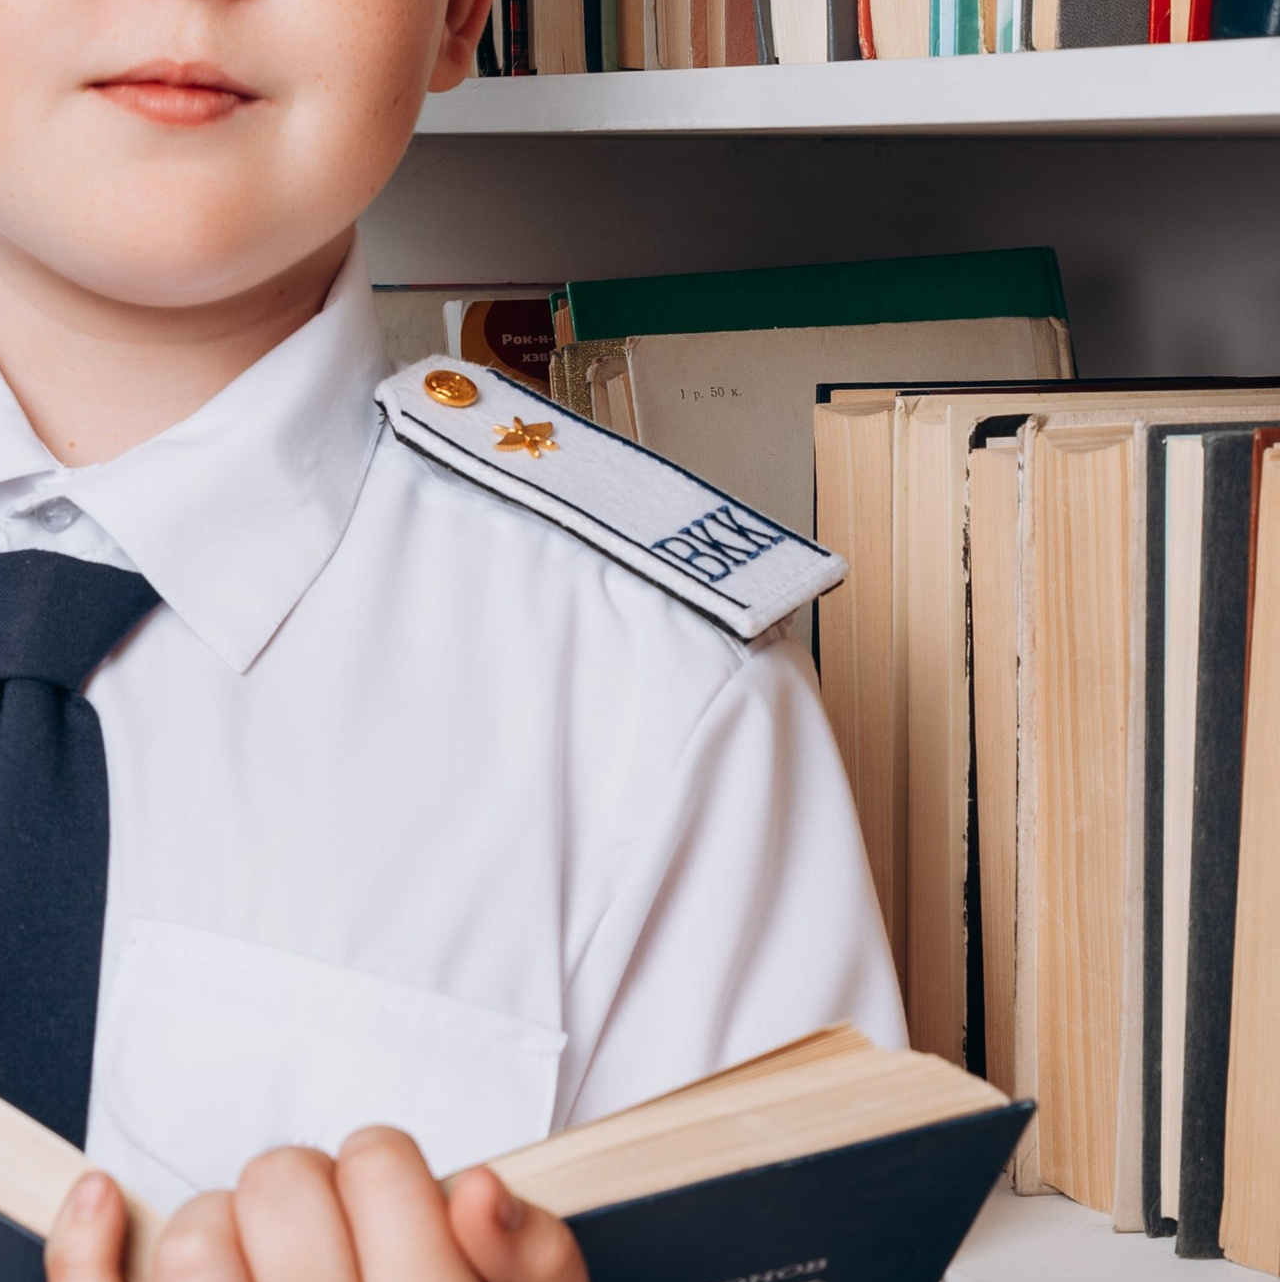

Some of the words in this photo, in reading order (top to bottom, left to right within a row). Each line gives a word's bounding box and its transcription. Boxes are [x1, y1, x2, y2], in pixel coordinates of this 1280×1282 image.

[502, 333, 554, 346] Рок-н-
[522, 353, 549, 362] хэв
[710, 386, 725, 398] 50
[651, 505, 786, 582] ВКК
